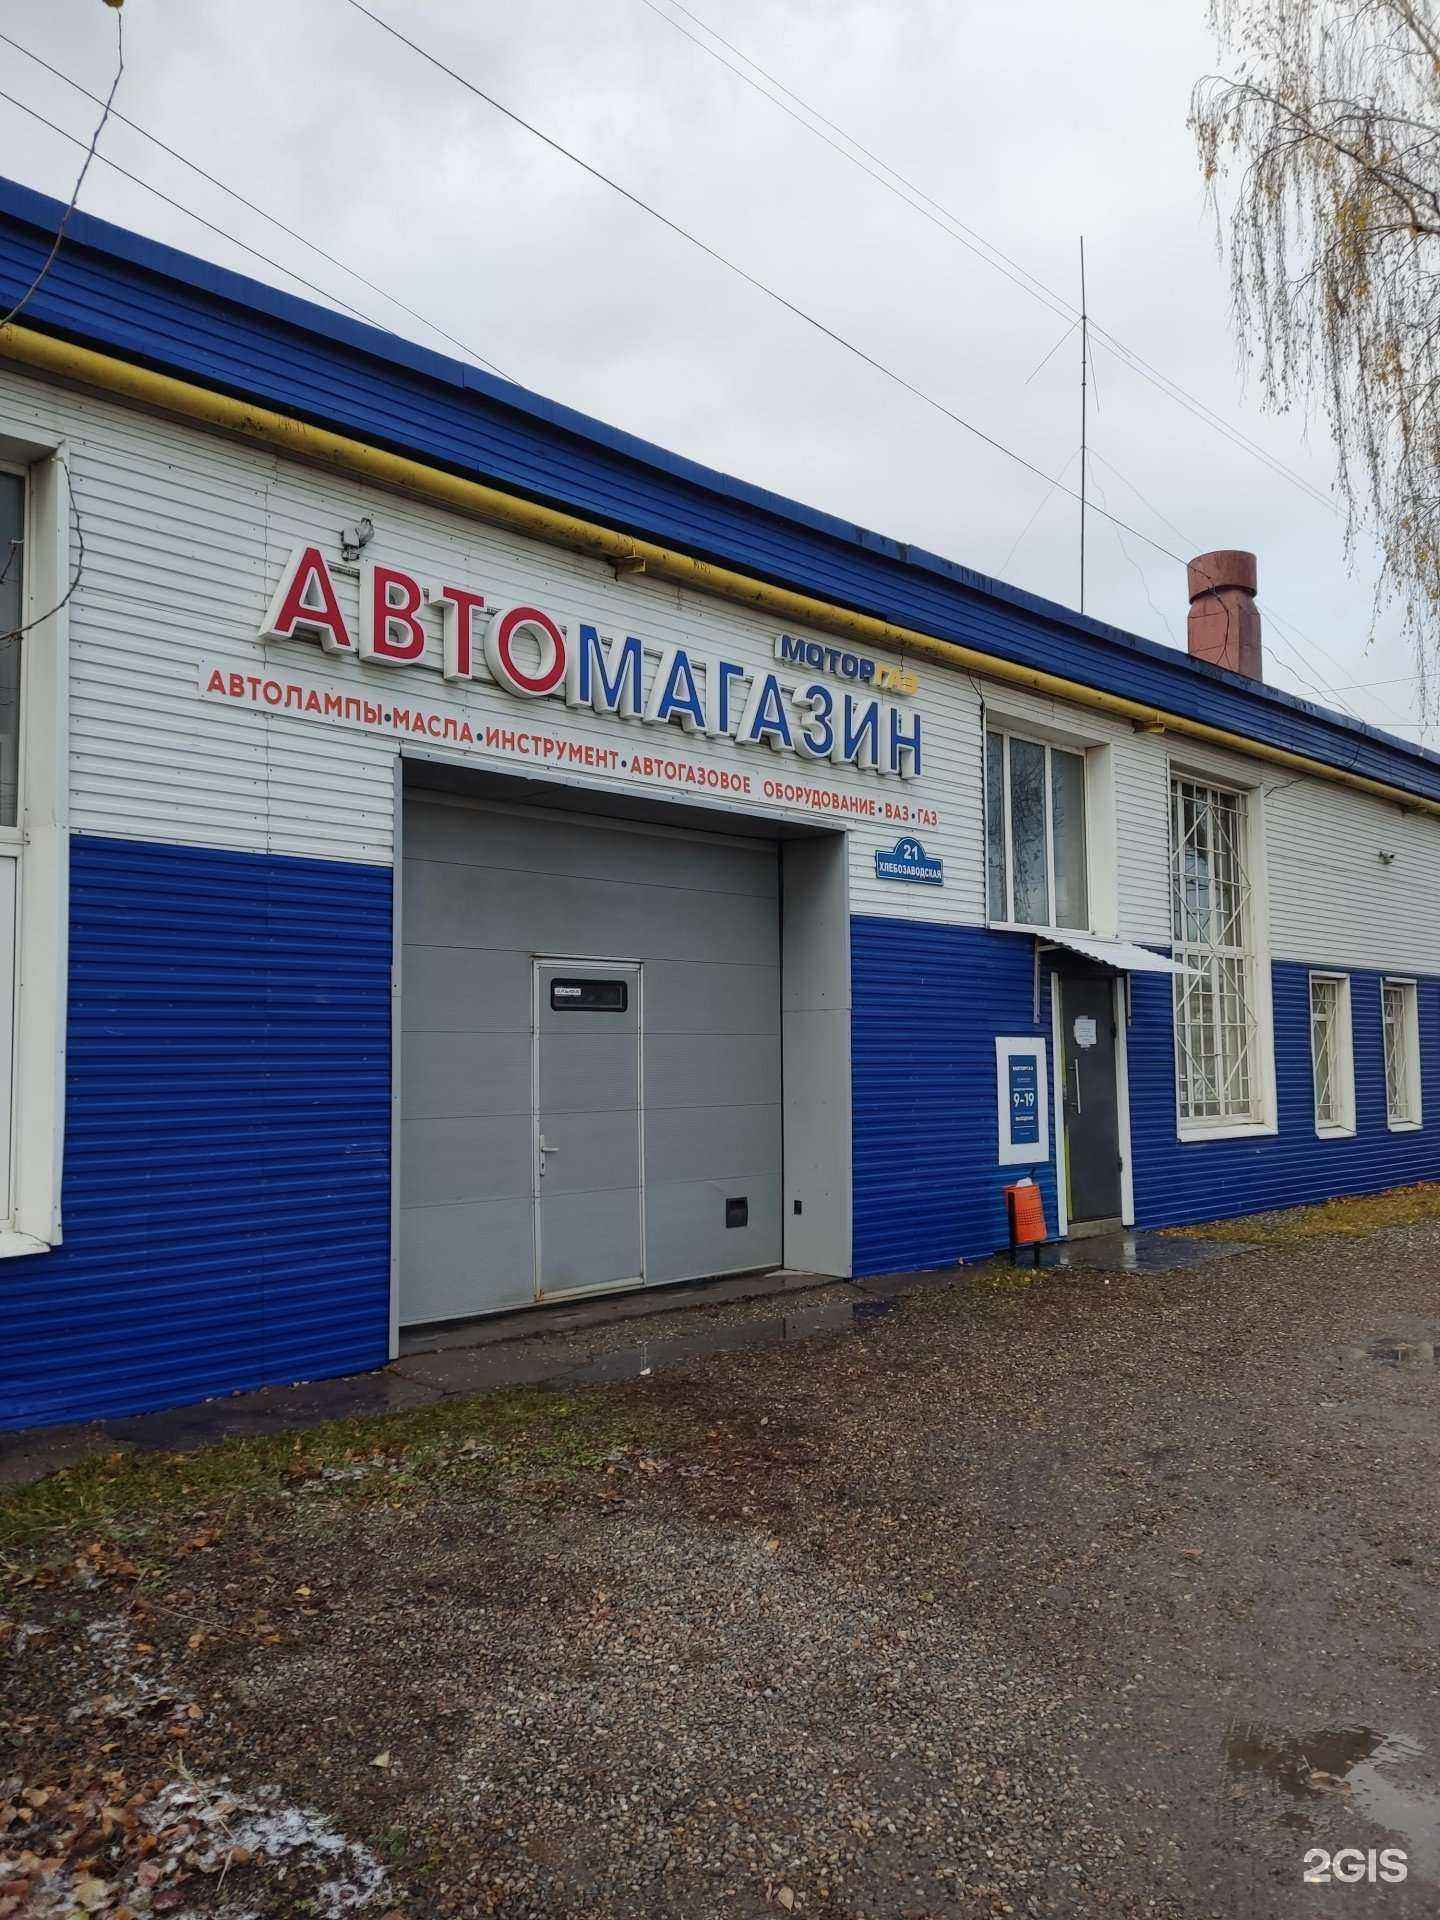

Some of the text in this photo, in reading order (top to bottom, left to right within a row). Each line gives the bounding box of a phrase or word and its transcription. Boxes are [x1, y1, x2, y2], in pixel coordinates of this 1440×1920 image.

[259, 544, 922, 779] АВТОМАГАЗИН
[206, 669, 938, 826] АВТОЛАМПЫ МАСЛА ИНСТРУМЕНТ АВТОГАЗОВОЕ ОБОРУДОВАНИЕ ВАЗ ГАЗ
[903, 844, 919, 861] 21
[879, 861, 942, 879] ХЛЕБОЗАВОДСКАЯ
[1013, 1092, 1035, 1108] 9-19
